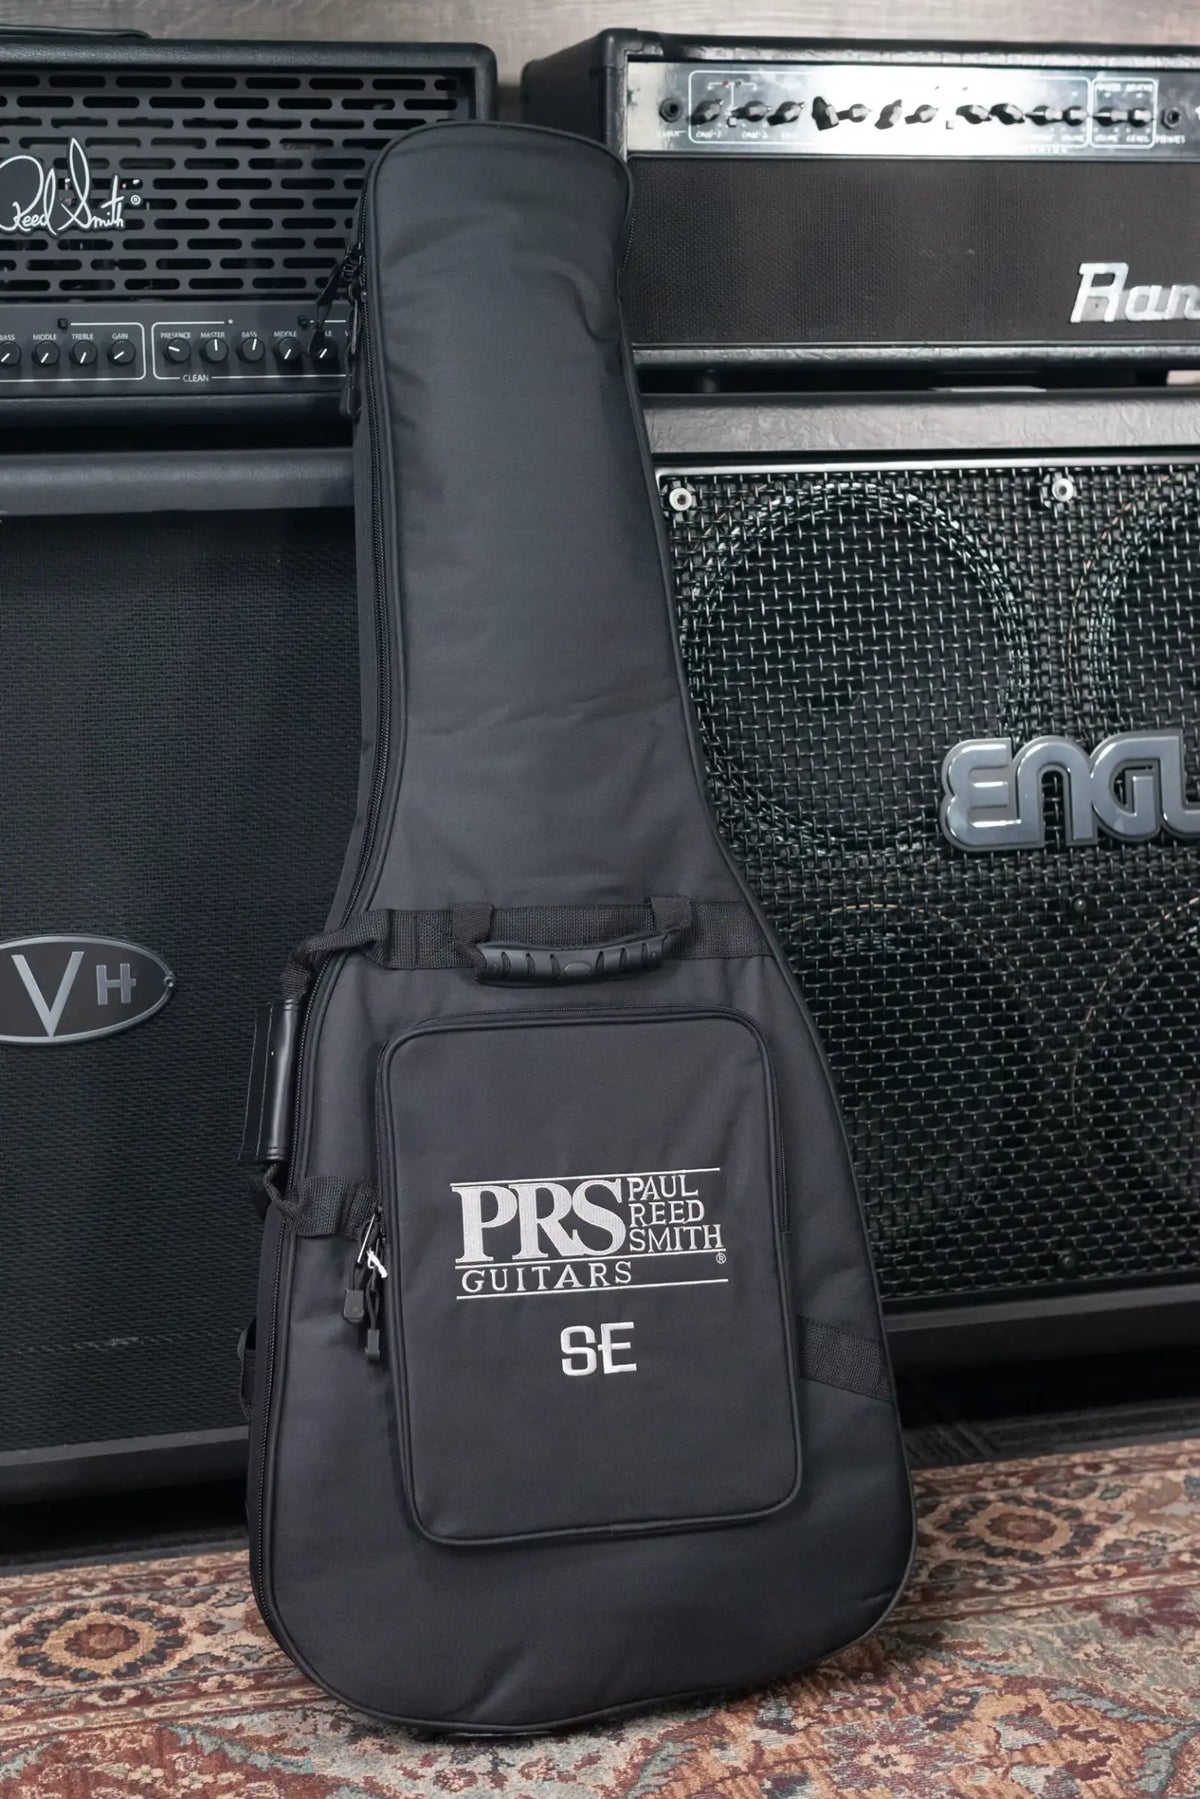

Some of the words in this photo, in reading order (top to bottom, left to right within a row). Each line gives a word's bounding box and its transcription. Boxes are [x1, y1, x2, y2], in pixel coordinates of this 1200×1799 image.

[32, 333, 58, 341] MIDDLE
[71, 332, 95, 341] TREBLE
[112, 332, 129, 340] GAIN
[160, 331, 191, 339] PRESENCE
[200, 331, 226, 339] MASTER
[241, 331, 258, 339] BASS
[182, 374, 209, 383] CLEAN
[626, 1174, 699, 1202] PAUL
[629, 1200, 705, 1228] REED
[451, 1178, 627, 1264] PRS
[629, 1223, 724, 1253] SMITH
[461, 1261, 632, 1294] GUITARS
[560, 1321, 638, 1377] SE
